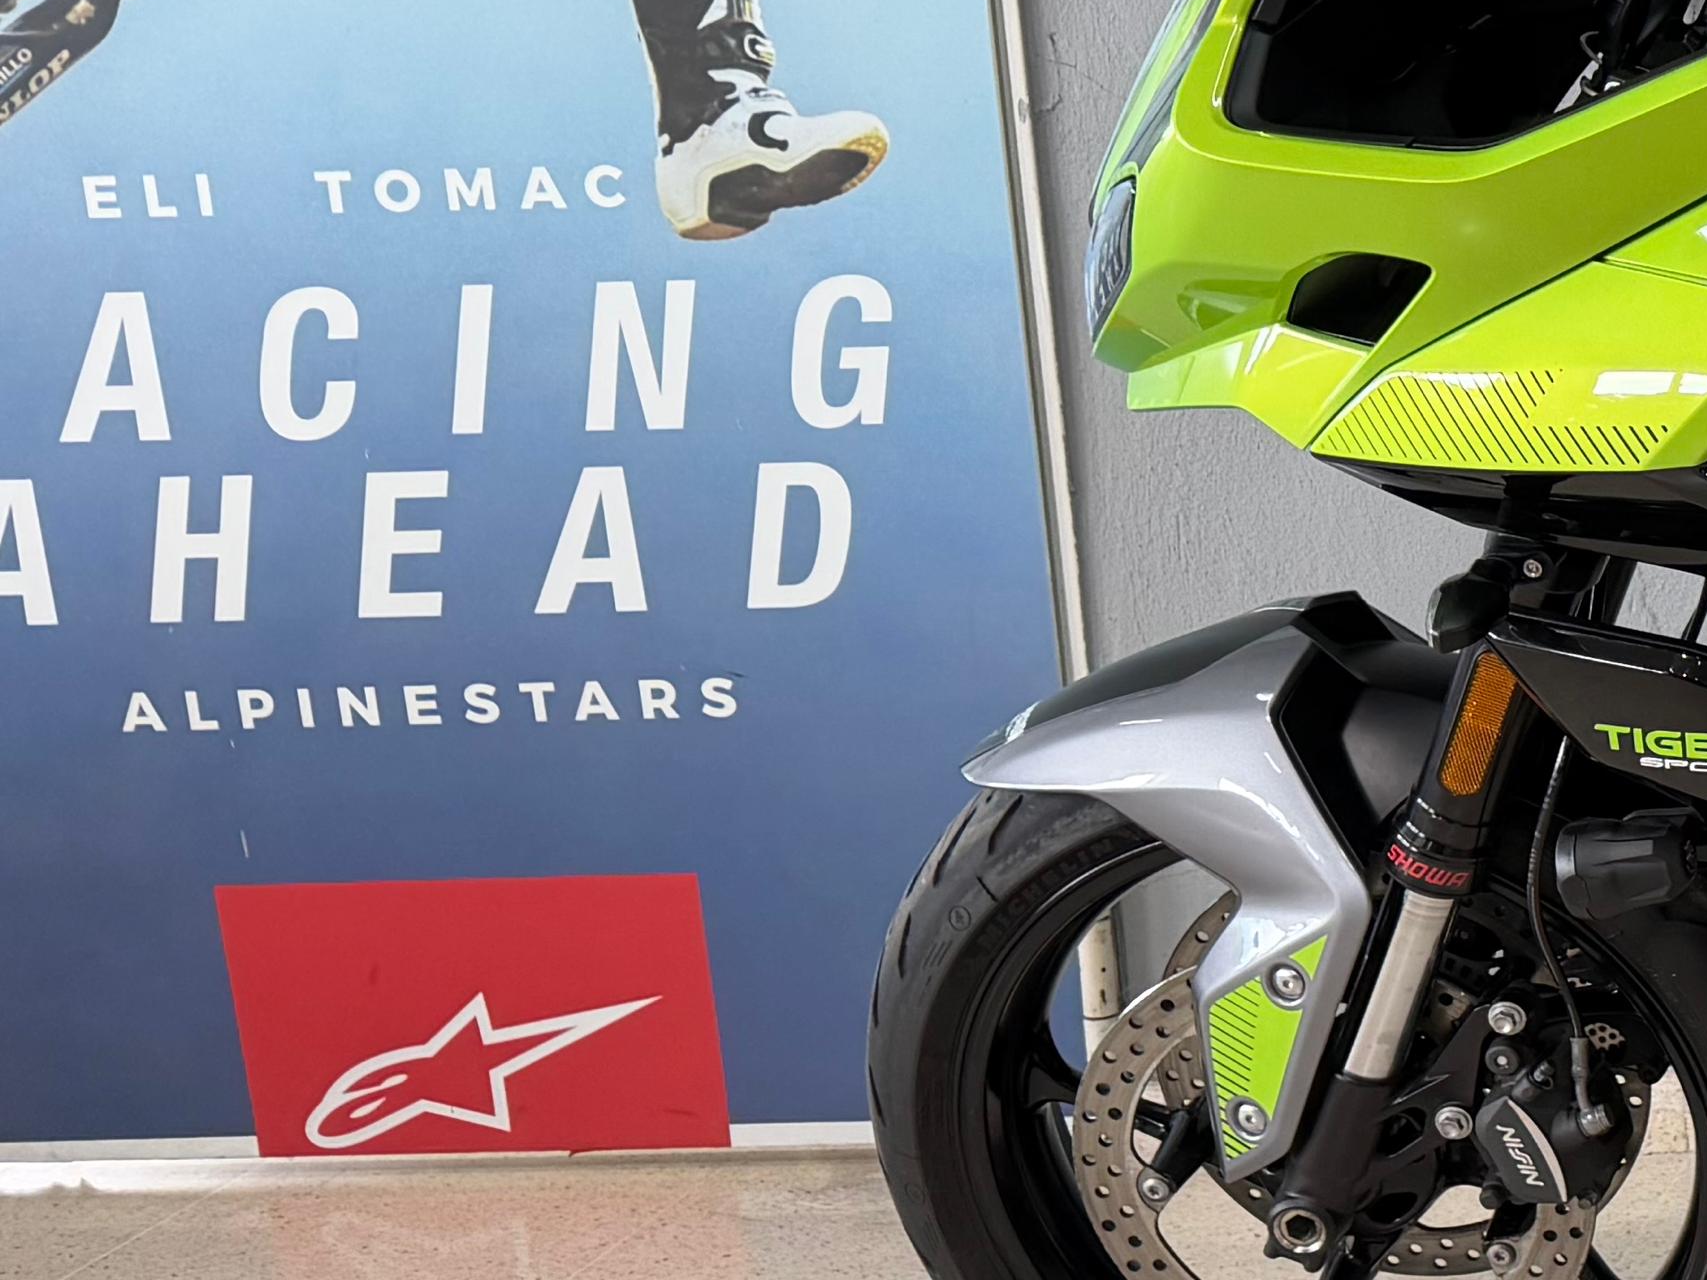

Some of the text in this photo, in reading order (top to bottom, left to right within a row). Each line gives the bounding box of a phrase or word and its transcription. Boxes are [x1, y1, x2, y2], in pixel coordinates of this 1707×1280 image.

[83, 164, 628, 219] ELI TOMAC
[0, 461, 853, 626] AHEAD
[122, 676, 740, 734] ALPINESTARS
[1386, 843, 1474, 889] SHOWA
